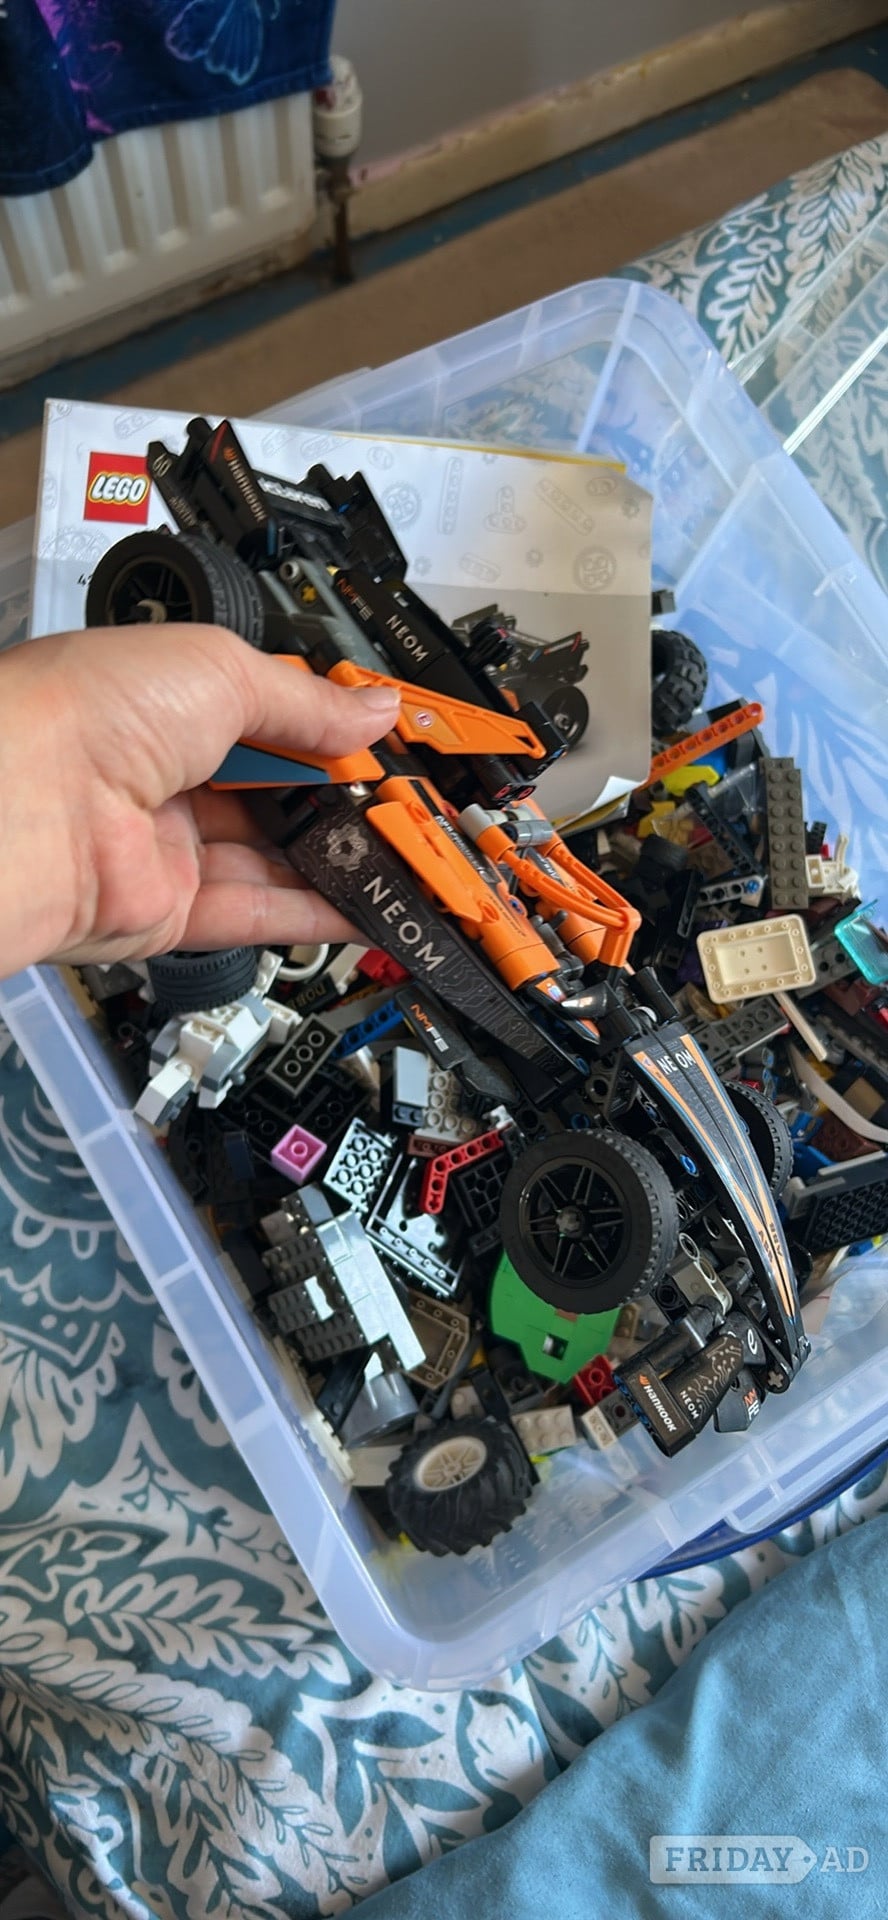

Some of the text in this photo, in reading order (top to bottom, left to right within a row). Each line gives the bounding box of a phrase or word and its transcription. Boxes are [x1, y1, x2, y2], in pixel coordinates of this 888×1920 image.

[91, 474, 147, 503] LEGO
[385, 614, 429, 662] NEOM
[363, 875, 446, 972] NEOM
[410, 1003, 449, 1053] NMFE
[679, 1389, 700, 1420] NEOM
